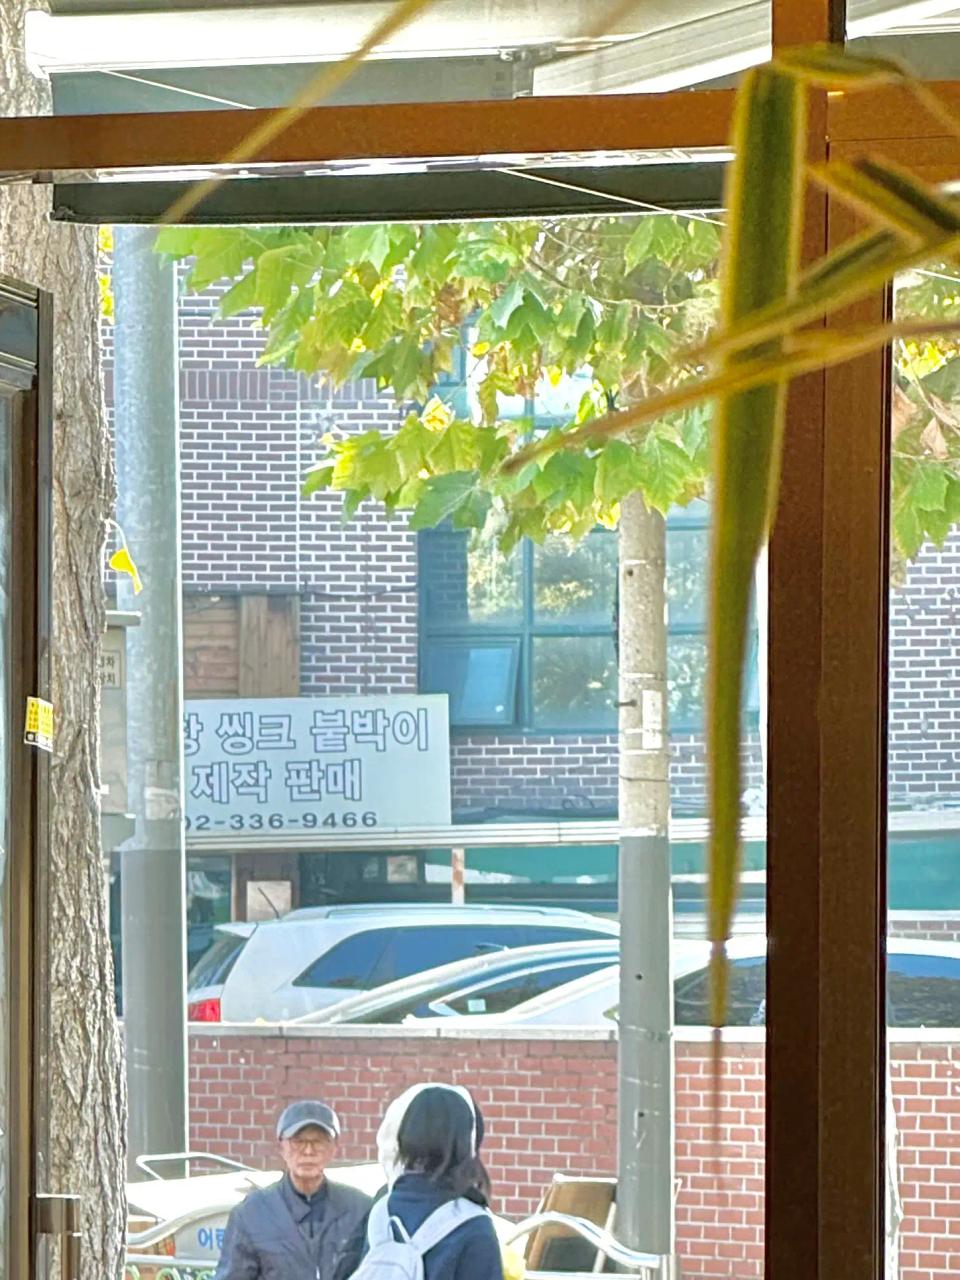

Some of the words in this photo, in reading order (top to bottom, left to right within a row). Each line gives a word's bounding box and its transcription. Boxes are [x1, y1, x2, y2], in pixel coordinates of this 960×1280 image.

[215, 711, 296, 756] 씽크
[310, 708, 428, 752] 붙박이
[190, 760, 272, 804] 제작
[285, 758, 363, 802] 판매
